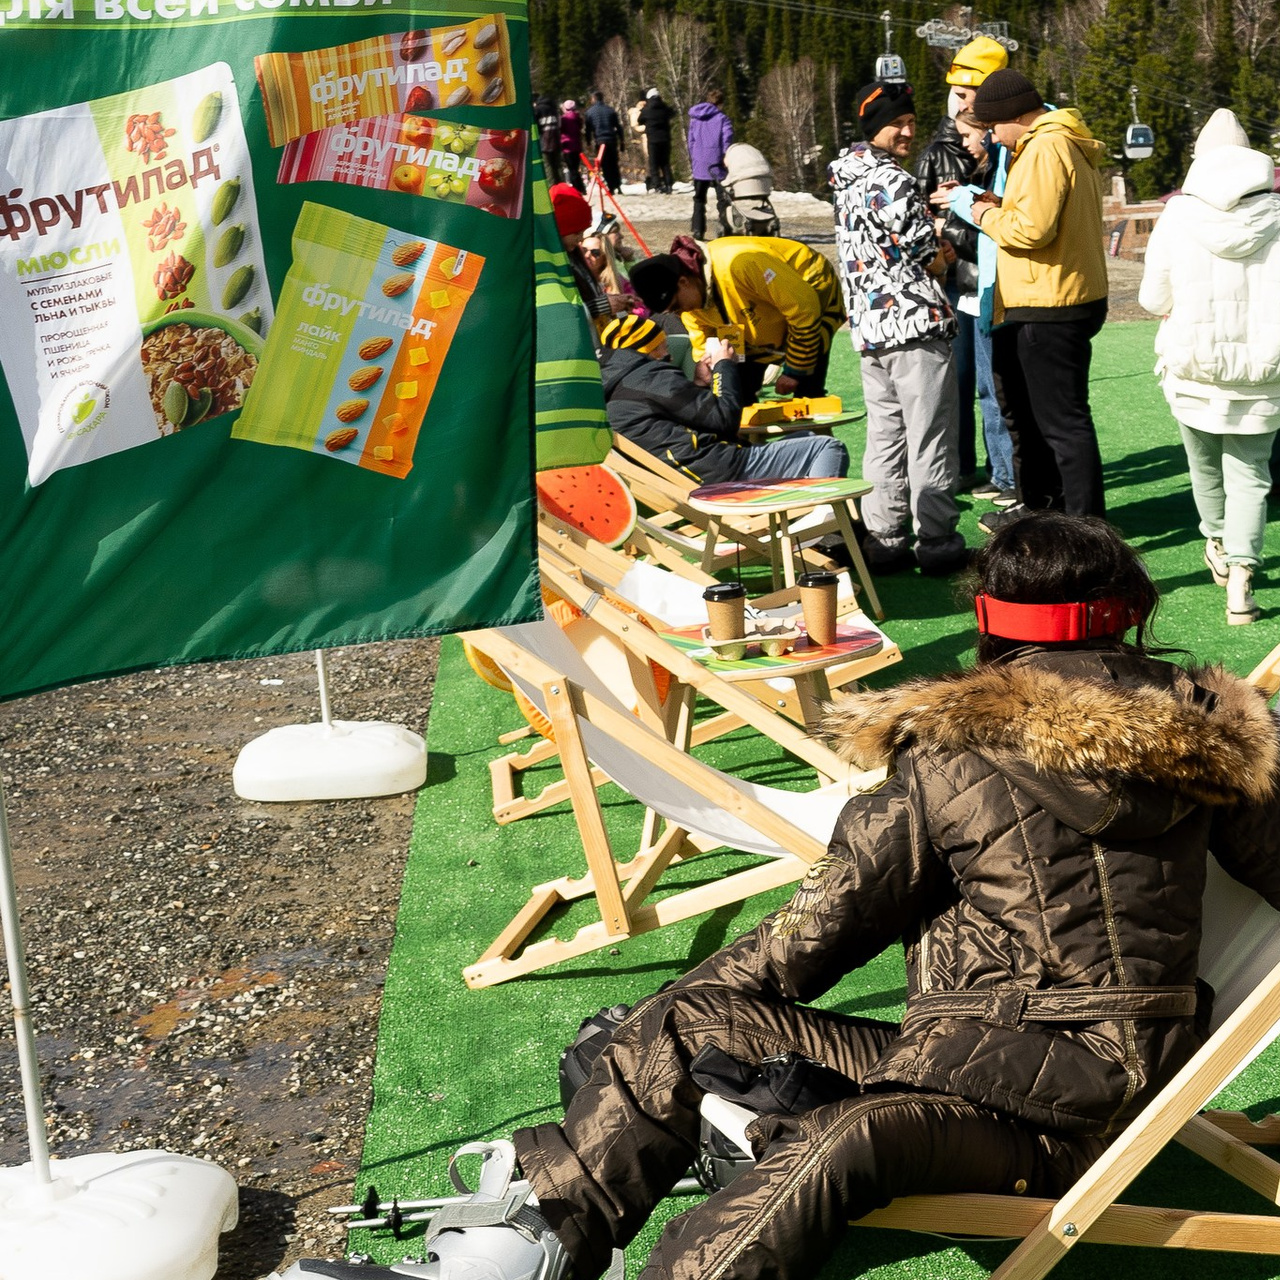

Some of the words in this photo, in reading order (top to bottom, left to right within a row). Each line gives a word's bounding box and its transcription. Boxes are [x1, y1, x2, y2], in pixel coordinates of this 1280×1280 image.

[310, 58, 469, 105] фрутилад
[331, 127, 482, 182] фрутилад
[26, 271, 113, 297] МУЛЬТИЗЛАКОВЫЕ
[30, 302, 39, 311] С
[40, 288, 103, 309] СЕМЕНАМИ
[302, 283, 433, 340] фрутилад
[34, 310, 67, 324] ЛЬНА
[69, 307, 78, 317] И
[43, 339, 91, 355] ПШЕНИЦА
